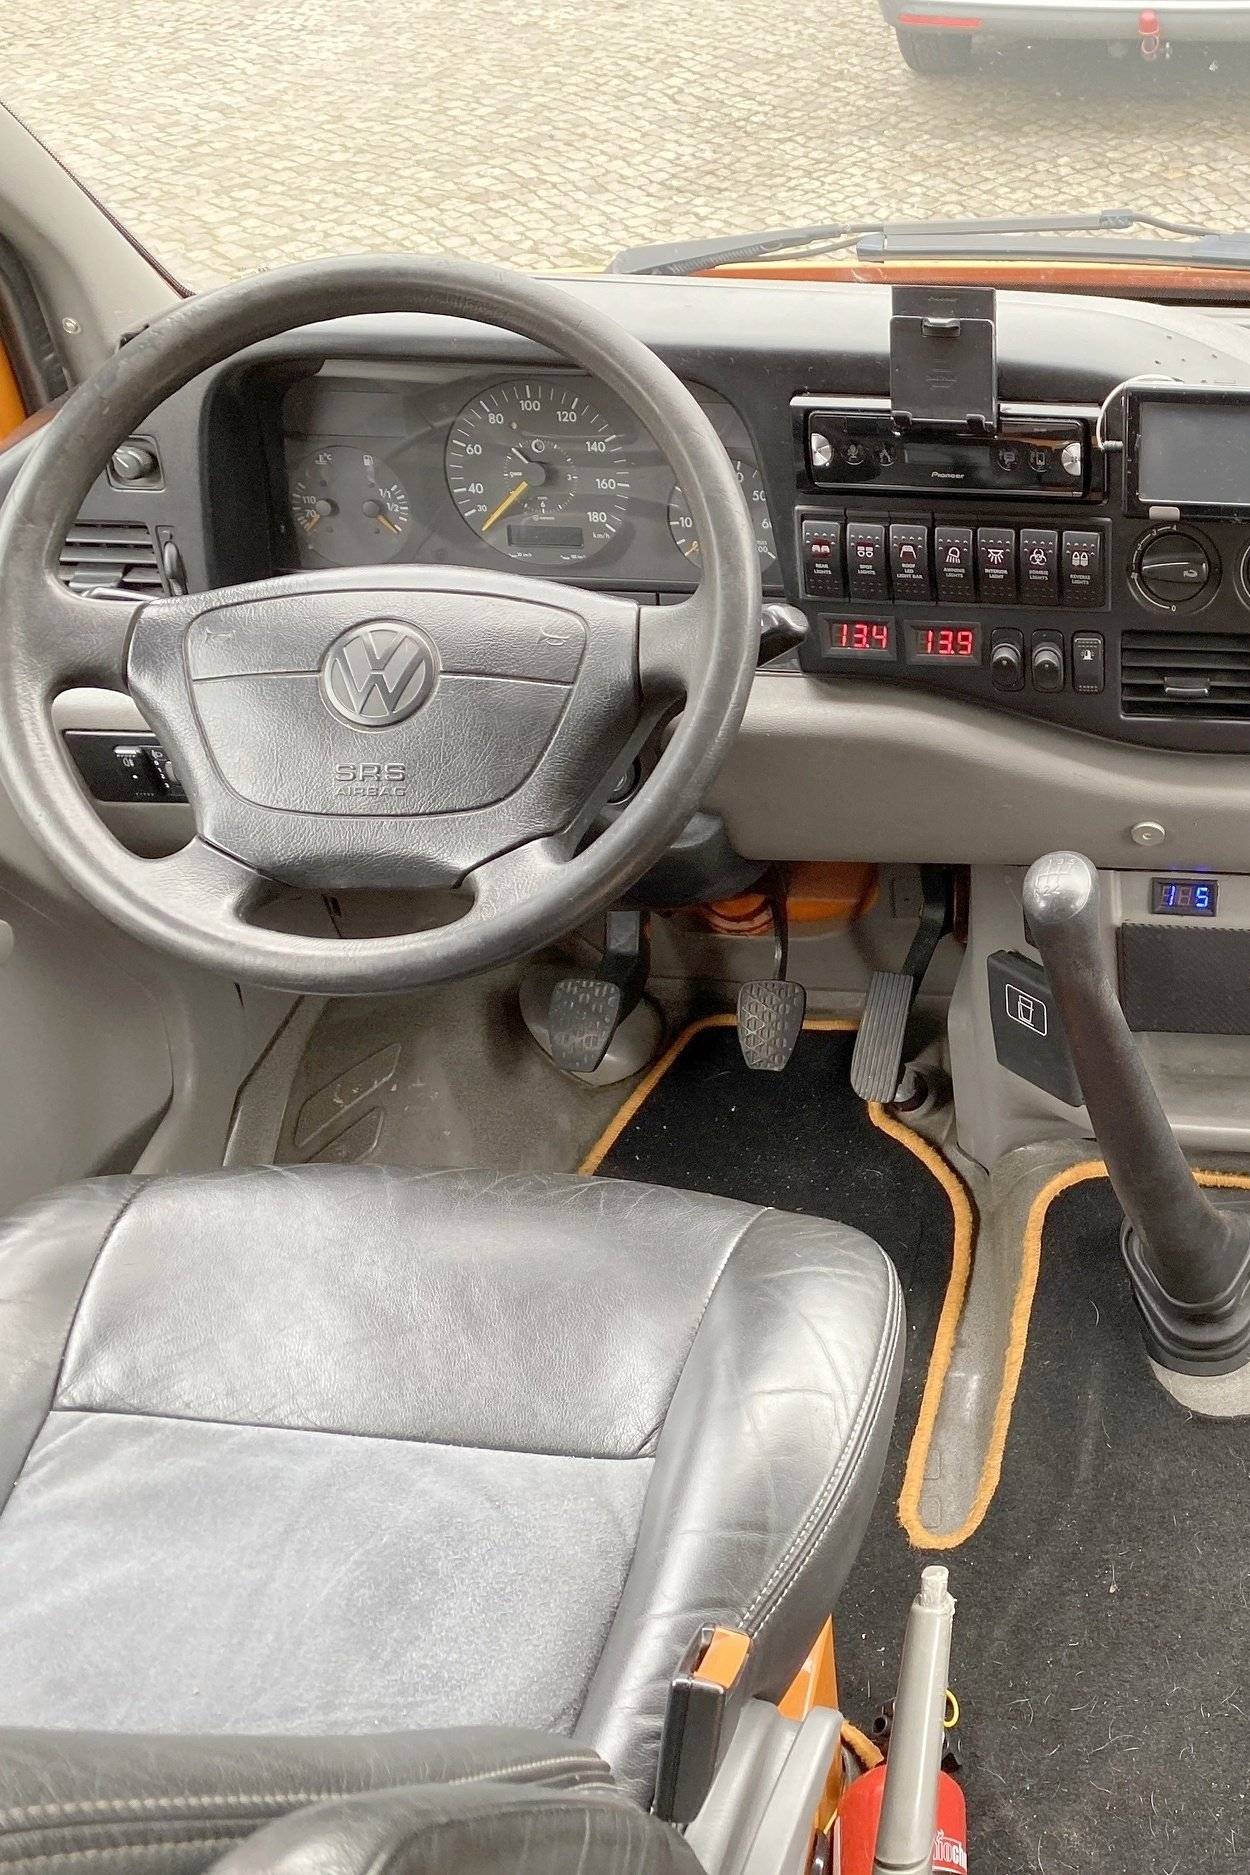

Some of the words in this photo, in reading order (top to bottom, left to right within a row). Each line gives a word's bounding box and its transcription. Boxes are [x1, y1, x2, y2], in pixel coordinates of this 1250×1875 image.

[519, 400, 540, 412] 100
[488, 412, 504, 424] 80
[556, 411, 577, 422] 120
[466, 444, 482, 455] 60
[586, 441, 606, 452] 140
[931, 471, 965, 480] Pioneer
[468, 483, 484, 494] 40
[596, 478, 616, 490] 160
[303, 496, 317, 504] 110
[387, 502, 400, 512] 1/2
[477, 505, 488, 513] 30
[587, 512, 607, 523] 180
[679, 517, 692, 528] 10
[592, 532, 611, 540] km/h
[841, 624, 888, 650] 13.4
[926, 630, 973, 655] 13.9
[334, 762, 406, 782] SRS
[334, 786, 407, 797] AIRBAG
